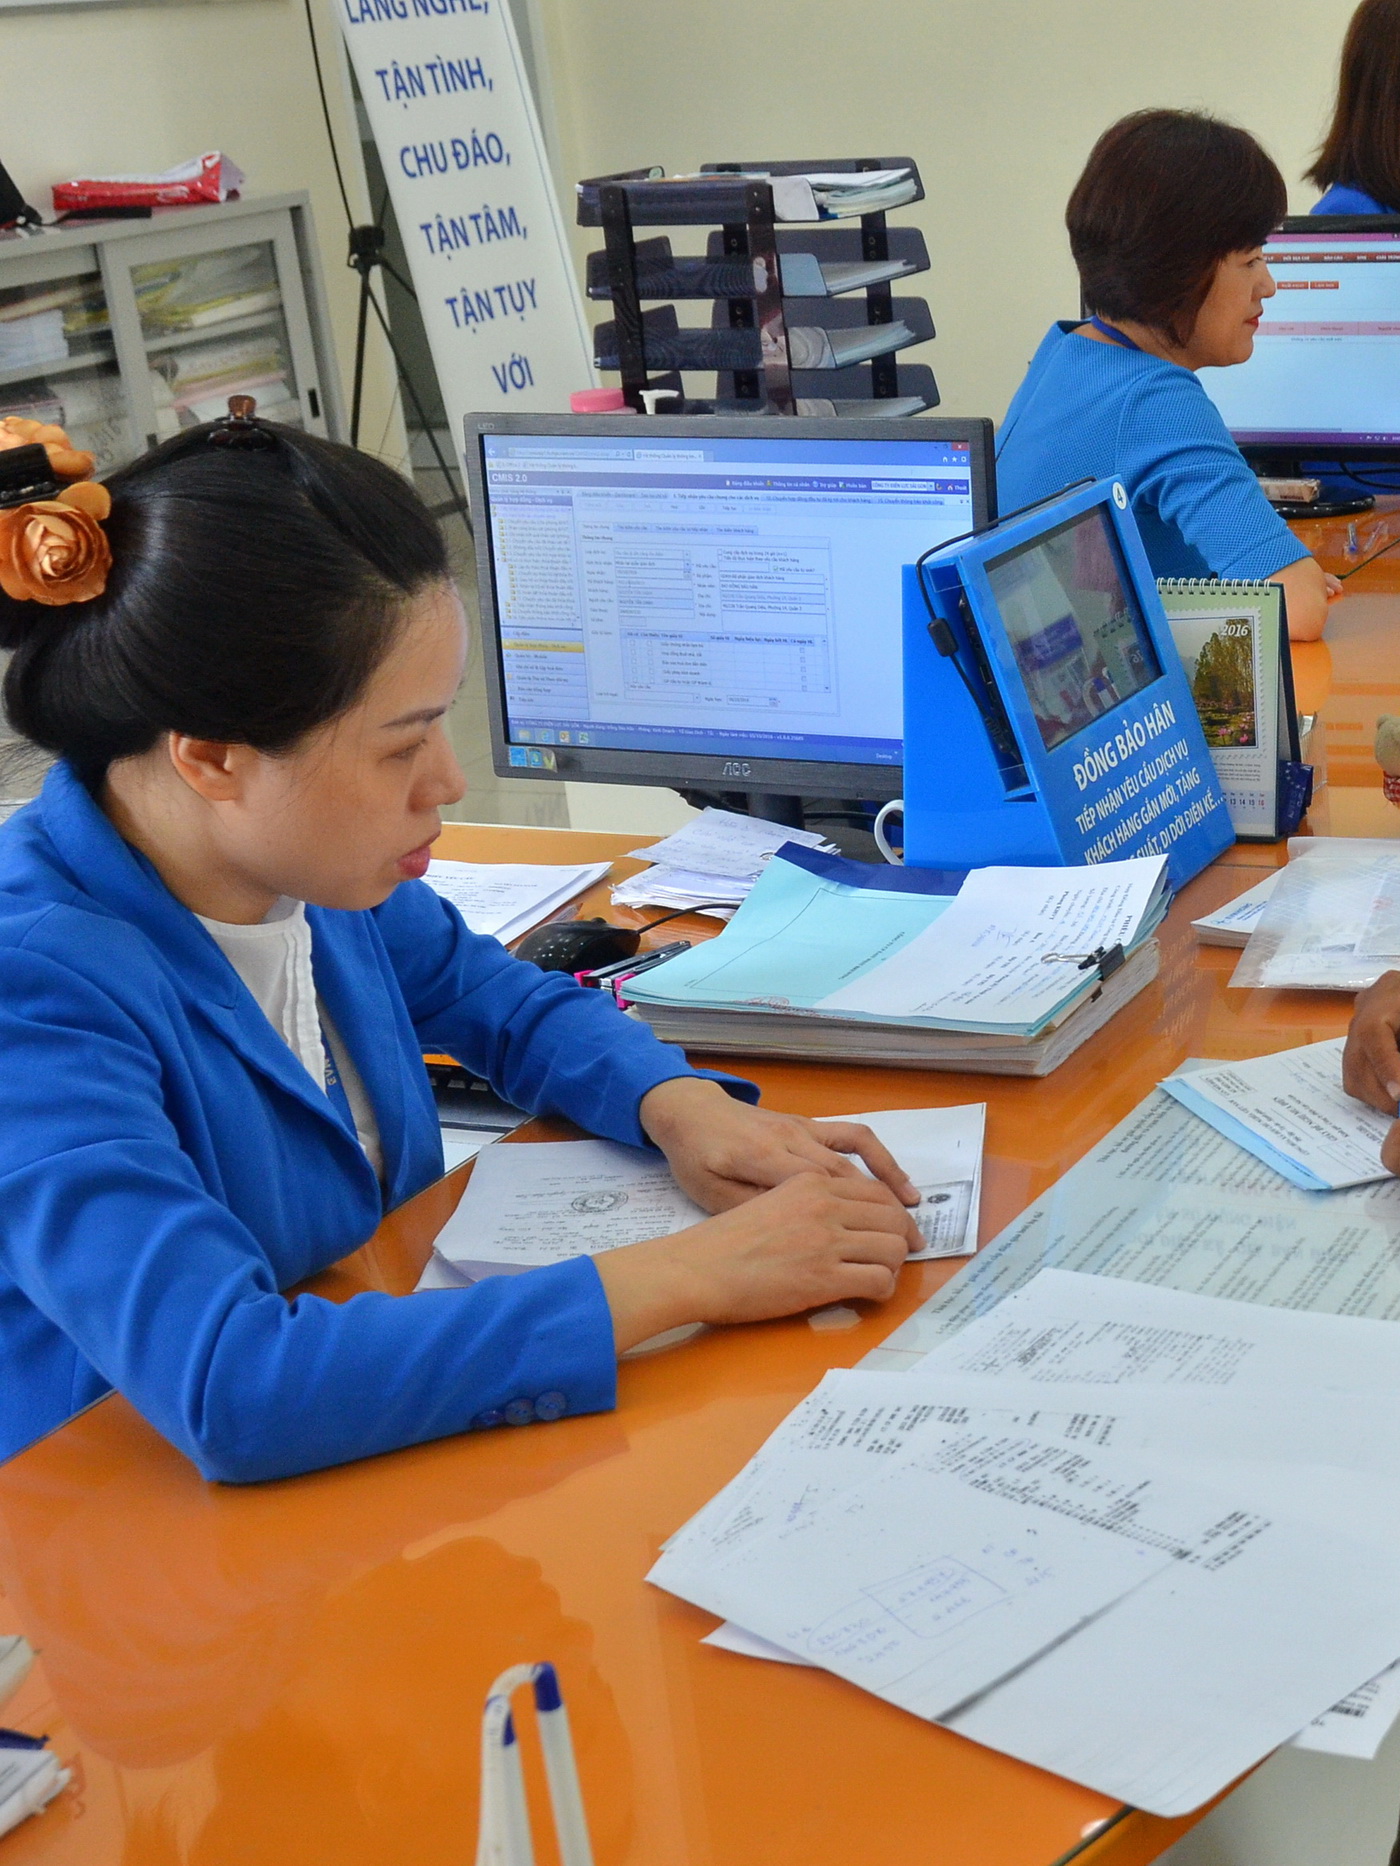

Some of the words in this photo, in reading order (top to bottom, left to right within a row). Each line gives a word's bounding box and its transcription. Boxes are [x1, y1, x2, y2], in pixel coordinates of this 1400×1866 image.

[375, 60, 426, 109] TẬN
[425, 54, 493, 93] TÌNH,
[400, 140, 448, 178] CHU
[451, 128, 511, 170] ĐÁO,
[419, 213, 470, 260] TẬN
[469, 203, 527, 244] TÂM,
[444, 287, 494, 333] TẬN
[494, 278, 537, 321] TỤY
[491, 352, 534, 394] VỚI
[491, 472, 514, 482] CMIS
[515, 473, 528, 483] 2.0
[1116, 487, 1124, 504] 4
[1220, 624, 1249, 637] 2016
[1073, 741, 1118, 791] ĐỒNG
[1115, 720, 1146, 761] BẢO
[1144, 700, 1176, 740] HÂN
[1075, 803, 1096, 834] TIẾP
[1095, 788, 1124, 820] NHẬN
[1120, 775, 1140, 801] YÊU
[1138, 760, 1157, 788] CẦU
[1155, 752, 1177, 776] DỊCH
[1175, 739, 1189, 761] VỤ
[1084, 832, 1117, 865] KHÁCH
[1115, 812, 1143, 845] HÀNG
[1140, 798, 1162, 825] GẮN
[1175, 767, 1201, 797] TĂNG
[1160, 830, 1172, 850] DI
[1170, 815, 1186, 842] DỜI
[1184, 803, 1208, 829] ĐIỆN
